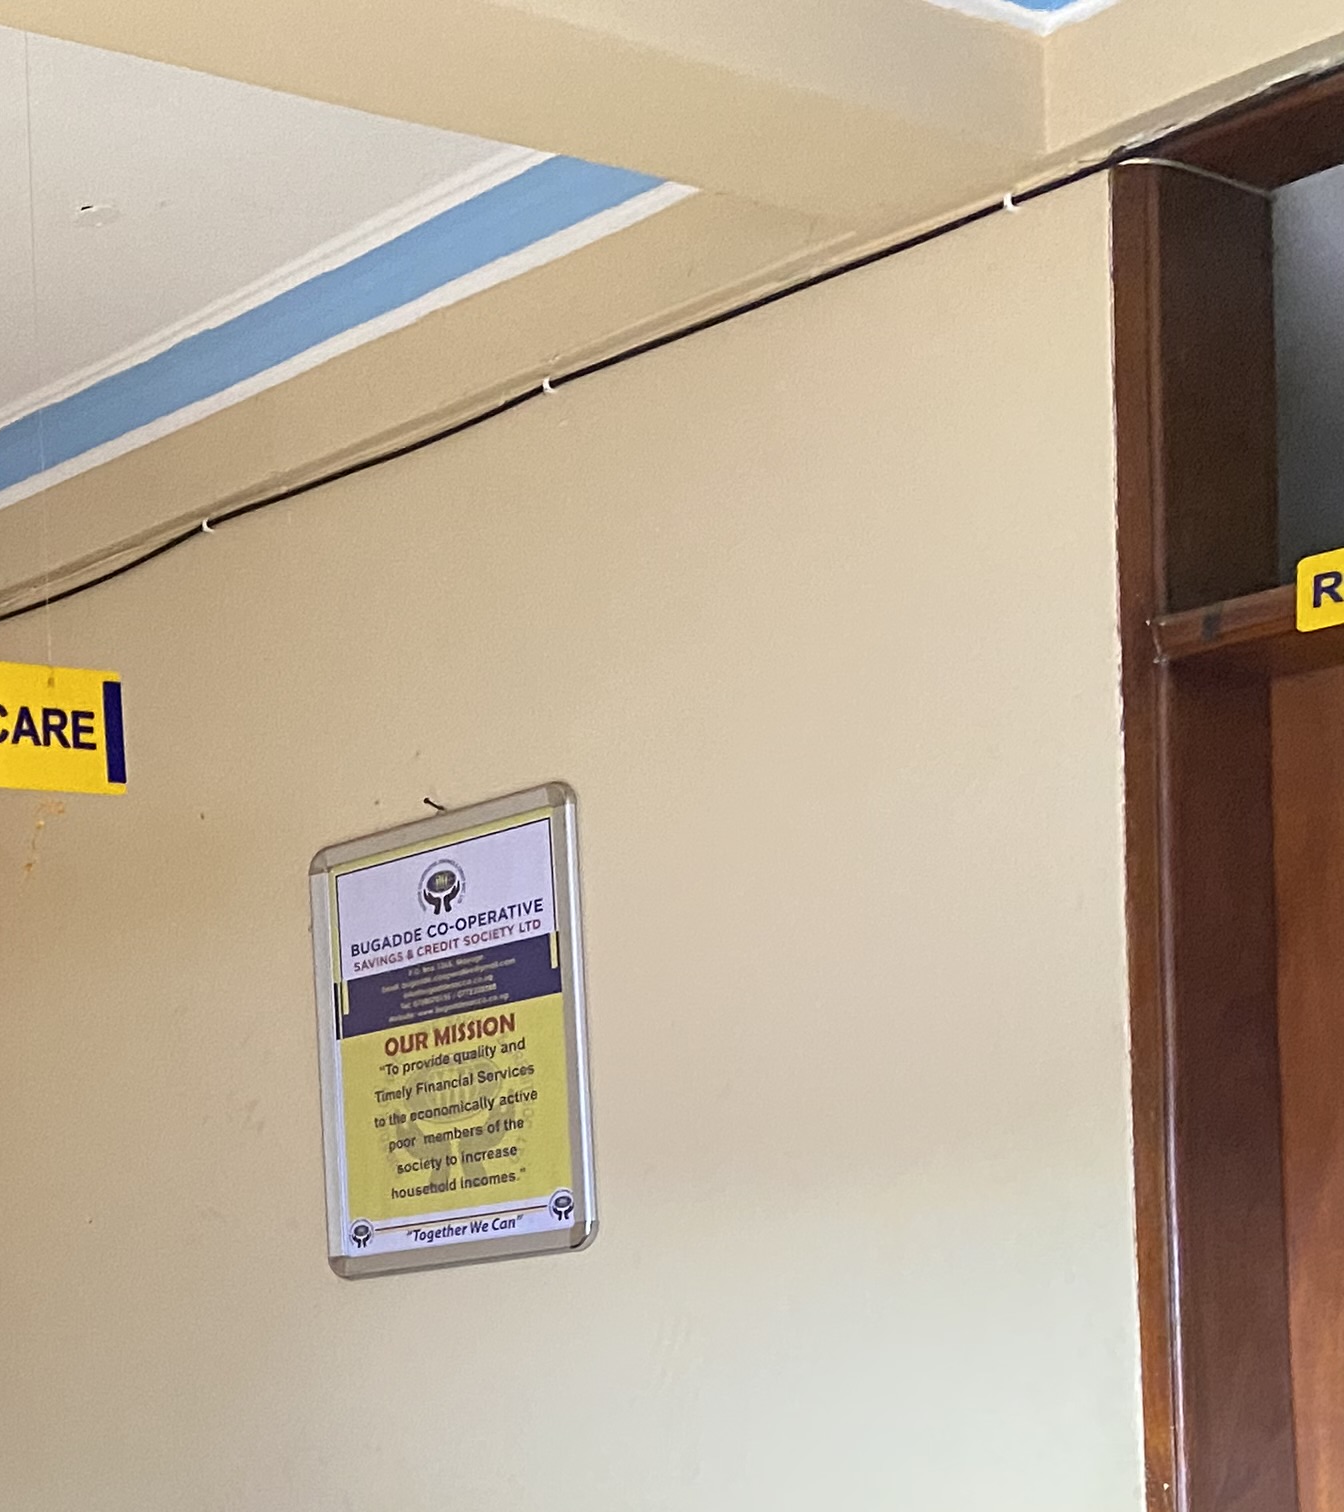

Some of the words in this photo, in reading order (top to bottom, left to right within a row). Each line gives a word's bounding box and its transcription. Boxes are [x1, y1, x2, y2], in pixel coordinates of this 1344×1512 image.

[351, 927, 422, 957] BUGADDE
[427, 898, 544, 938] CO-OPERATIVE
[353, 950, 404, 972] SAVINGS
[406, 949, 414, 960] &
[417, 938, 459, 957] CREDIT
[463, 924, 515, 946] SOCIETY
[518, 919, 542, 933] LTD
[384, 1032, 428, 1056] OUR
[434, 1013, 515, 1047] MISSION
[402, 1053, 450, 1077] provide
[453, 1043, 497, 1065] quality
[500, 1037, 526, 1054] and
[374, 1085, 412, 1104] Timely
[416, 1073, 474, 1095] Financial
[477, 1063, 535, 1084] Services
[374, 1116, 386, 1128] to
[389, 1112, 407, 1126] the
[410, 1096, 495, 1122] economically
[499, 1089, 538, 1106] active
[388, 1135, 416, 1153] poor
[423, 1124, 484, 1144] members
[487, 1119, 501, 1134] of
[504, 1117, 525, 1131] the
[397, 1153, 443, 1175] society
[445, 1154, 458, 1166] to
[461, 1145, 518, 1163] increase
[391, 1180, 457, 1200] household
[470, 1220, 490, 1234] We
